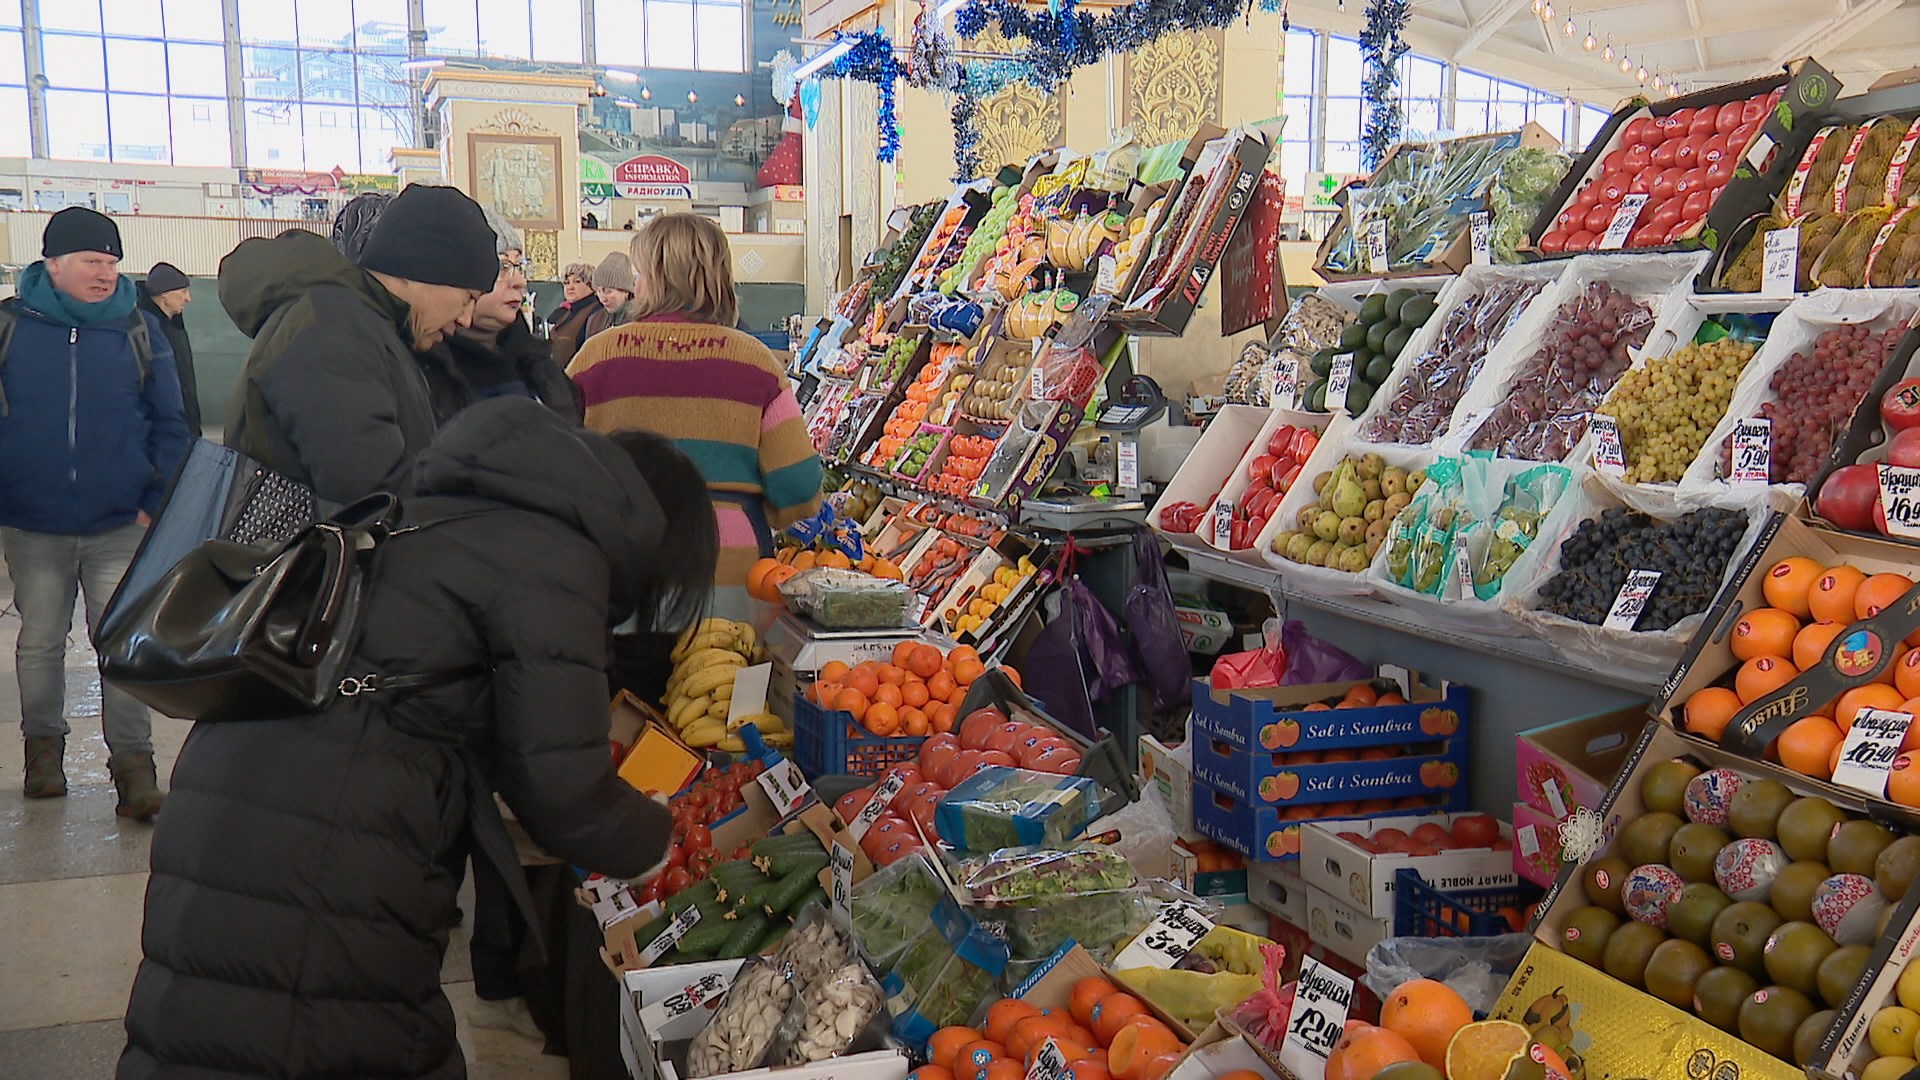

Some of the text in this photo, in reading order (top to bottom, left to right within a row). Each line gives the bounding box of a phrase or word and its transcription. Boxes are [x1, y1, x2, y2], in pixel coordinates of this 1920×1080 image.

[624, 164, 680, 174] СПРАВКА
[627, 187, 683, 196] РАДИОУЗЕЛ
[1194, 713, 1208, 730] Sol
[1213, 721, 1247, 745] Sombra
[1306, 718, 1414, 740] Sol i Sombra
[1195, 763, 1208, 778] Sol
[1214, 771, 1247, 798] Sombra
[1306, 770, 1414, 792] Sol i Sombra
[1196, 818, 1211, 834] Sol
[1217, 828, 1250, 855] Sombra
[1441, 876, 1474, 888] NOBLE
[1478, 874, 1513, 885] SMART
